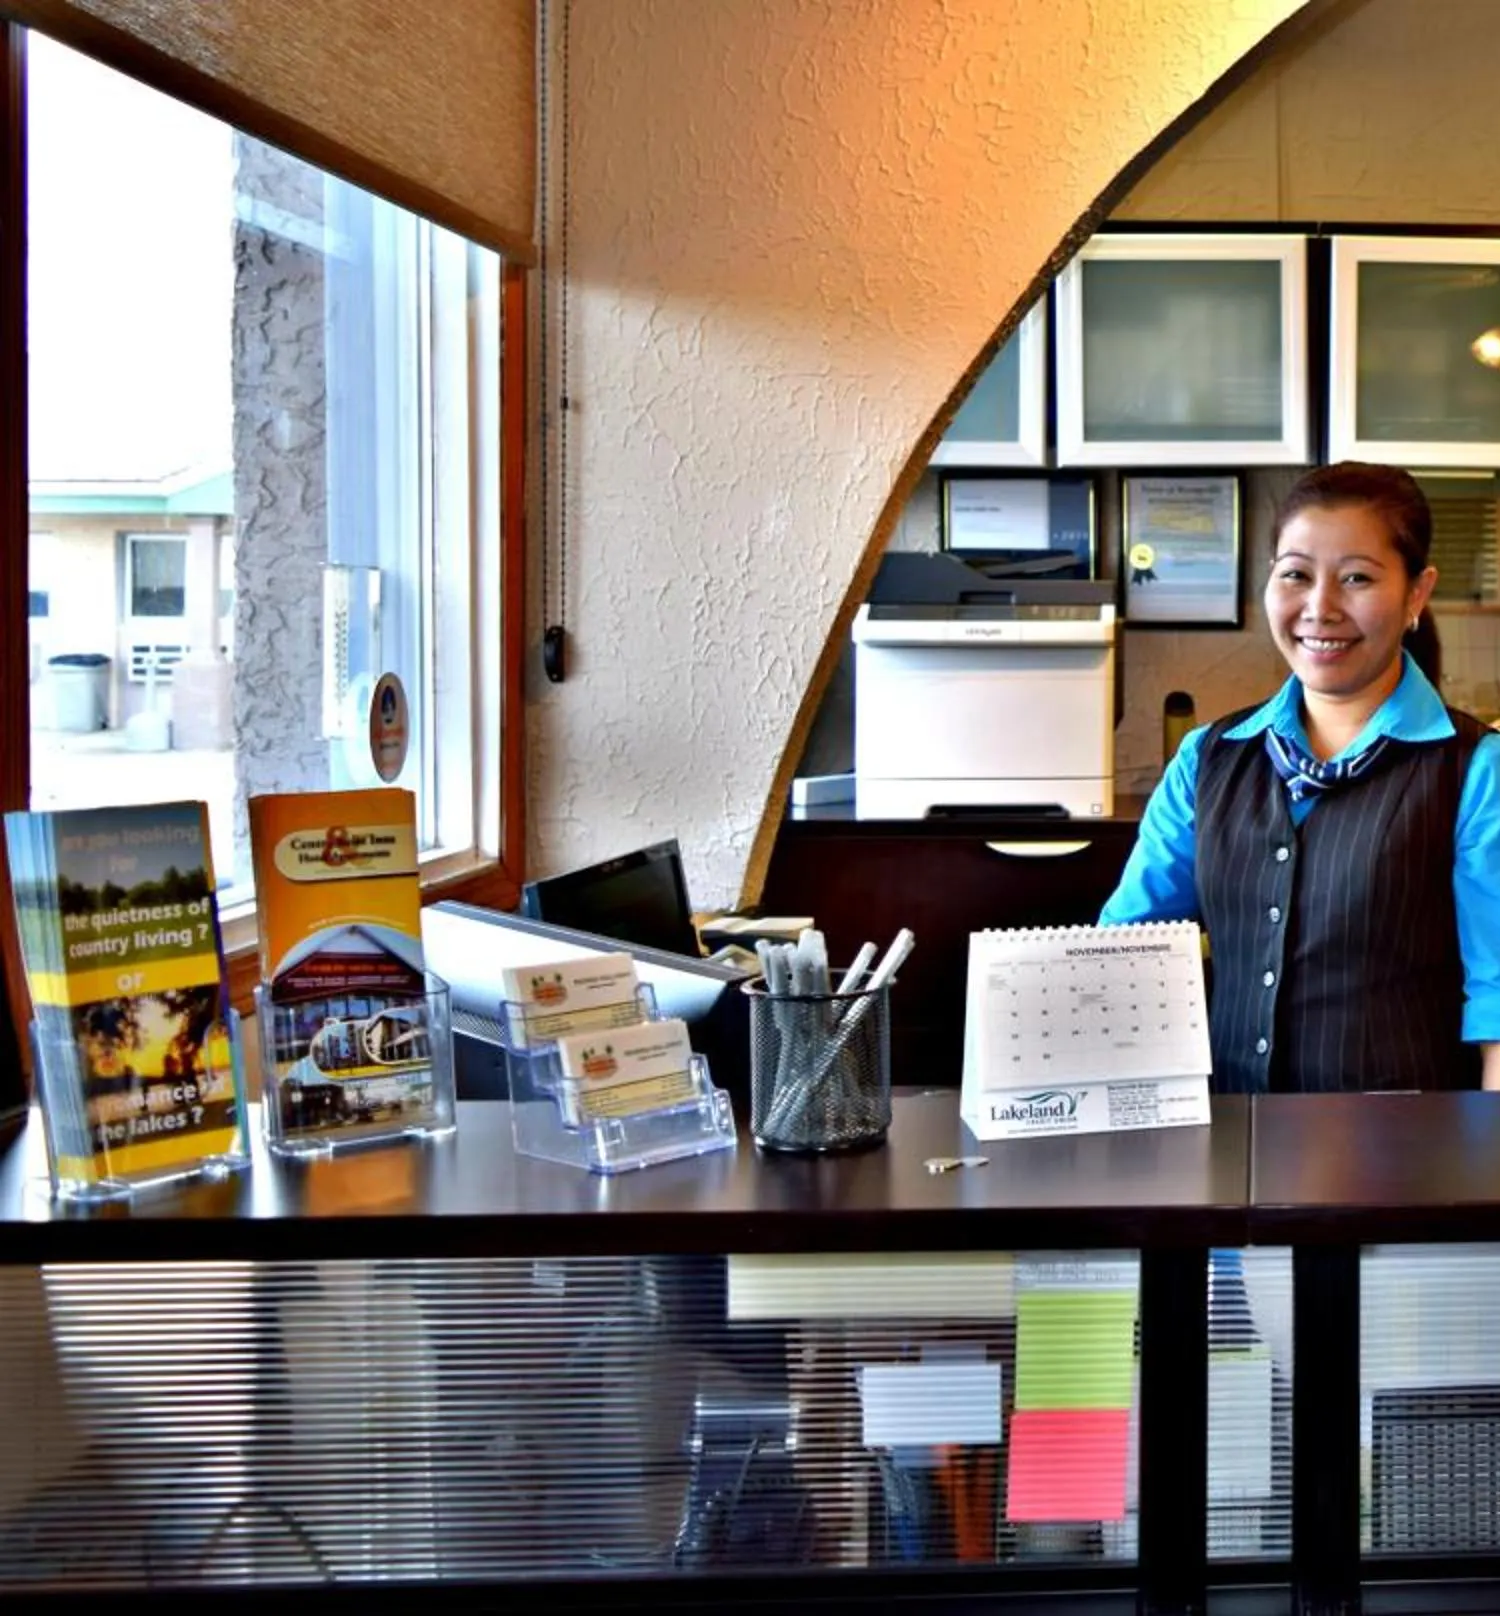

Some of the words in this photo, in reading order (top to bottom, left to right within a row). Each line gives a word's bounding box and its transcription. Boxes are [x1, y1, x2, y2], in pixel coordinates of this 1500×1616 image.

[64, 912, 88, 931] the
[90, 899, 183, 933] quietness
[188, 897, 210, 916] of
[69, 936, 129, 958] country
[134, 928, 194, 949] living
[198, 923, 209, 940] ?
[116, 971, 145, 992] or
[130, 1111, 188, 1135] lakes
[991, 1102, 1065, 1121] Lakeland
